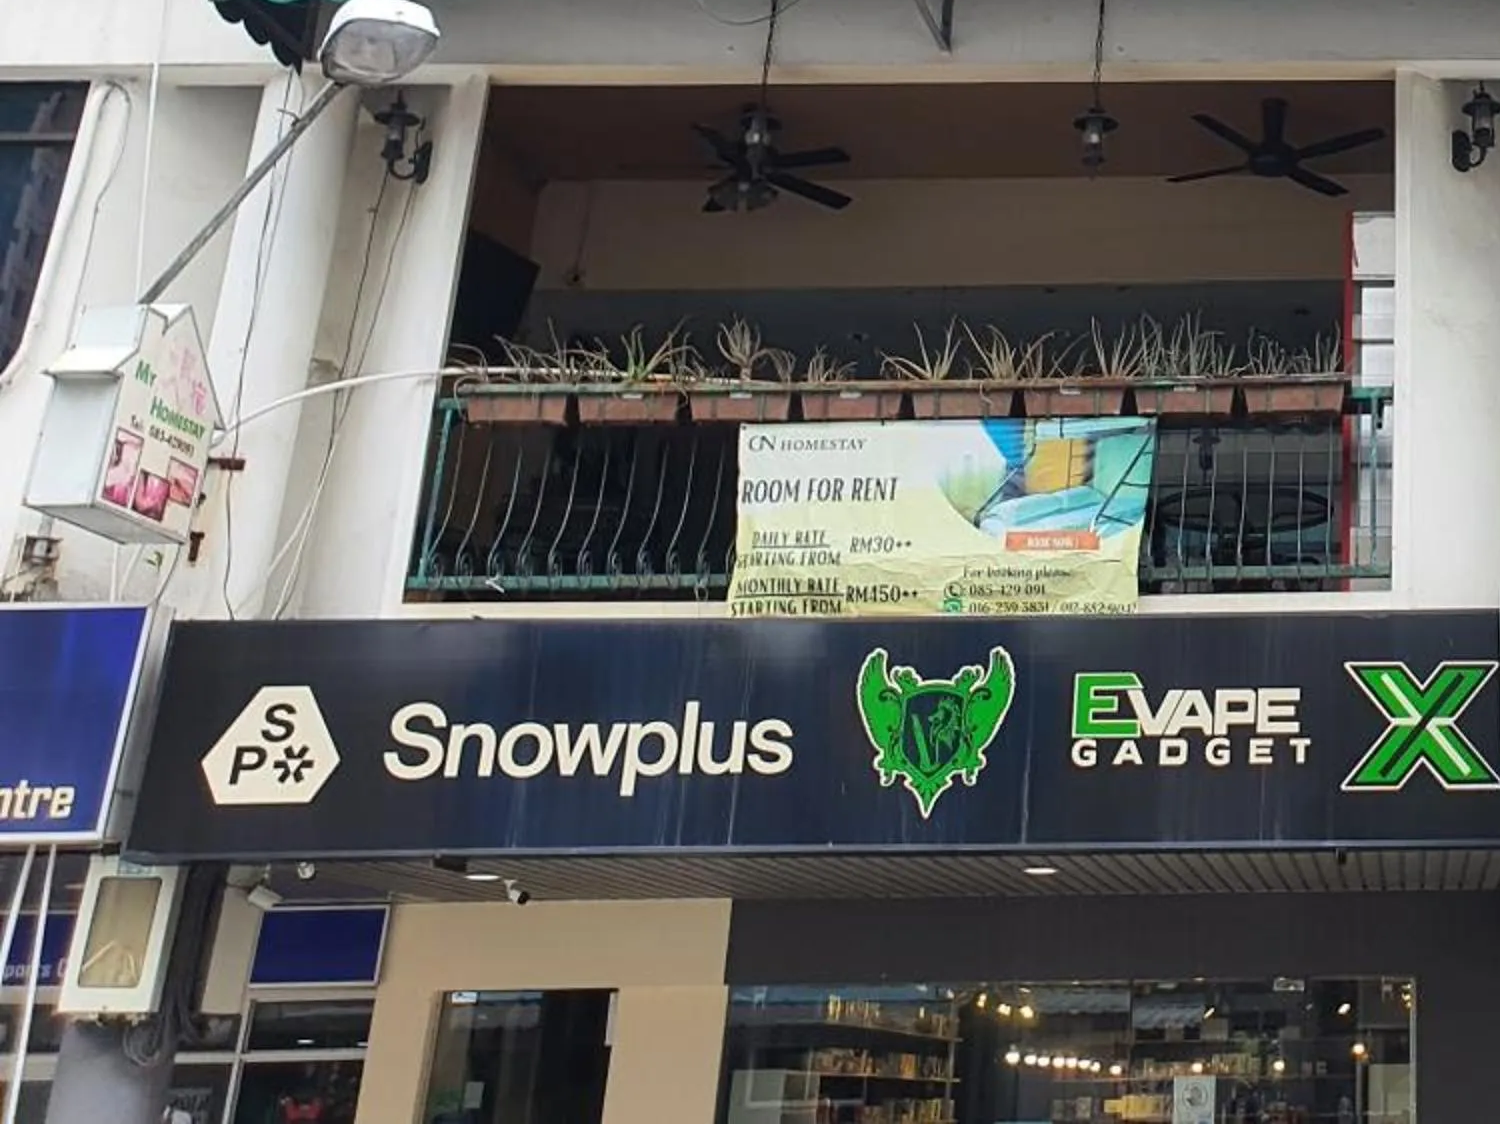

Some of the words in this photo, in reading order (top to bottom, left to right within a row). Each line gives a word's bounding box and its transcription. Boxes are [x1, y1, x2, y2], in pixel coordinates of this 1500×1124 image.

[780, 438, 866, 452] HOMESTAY
[742, 479, 801, 504] ROOM
[807, 478, 845, 502] FOR
[852, 477, 898, 502] RENT
[807, 577, 840, 592] RATE
[731, 600, 797, 616] STARTING
[803, 598, 842, 614] FROM
[1072, 672, 1301, 738] EVAPE
[384, 701, 794, 797] Snowplus
[1071, 738, 1312, 766] GADGET
